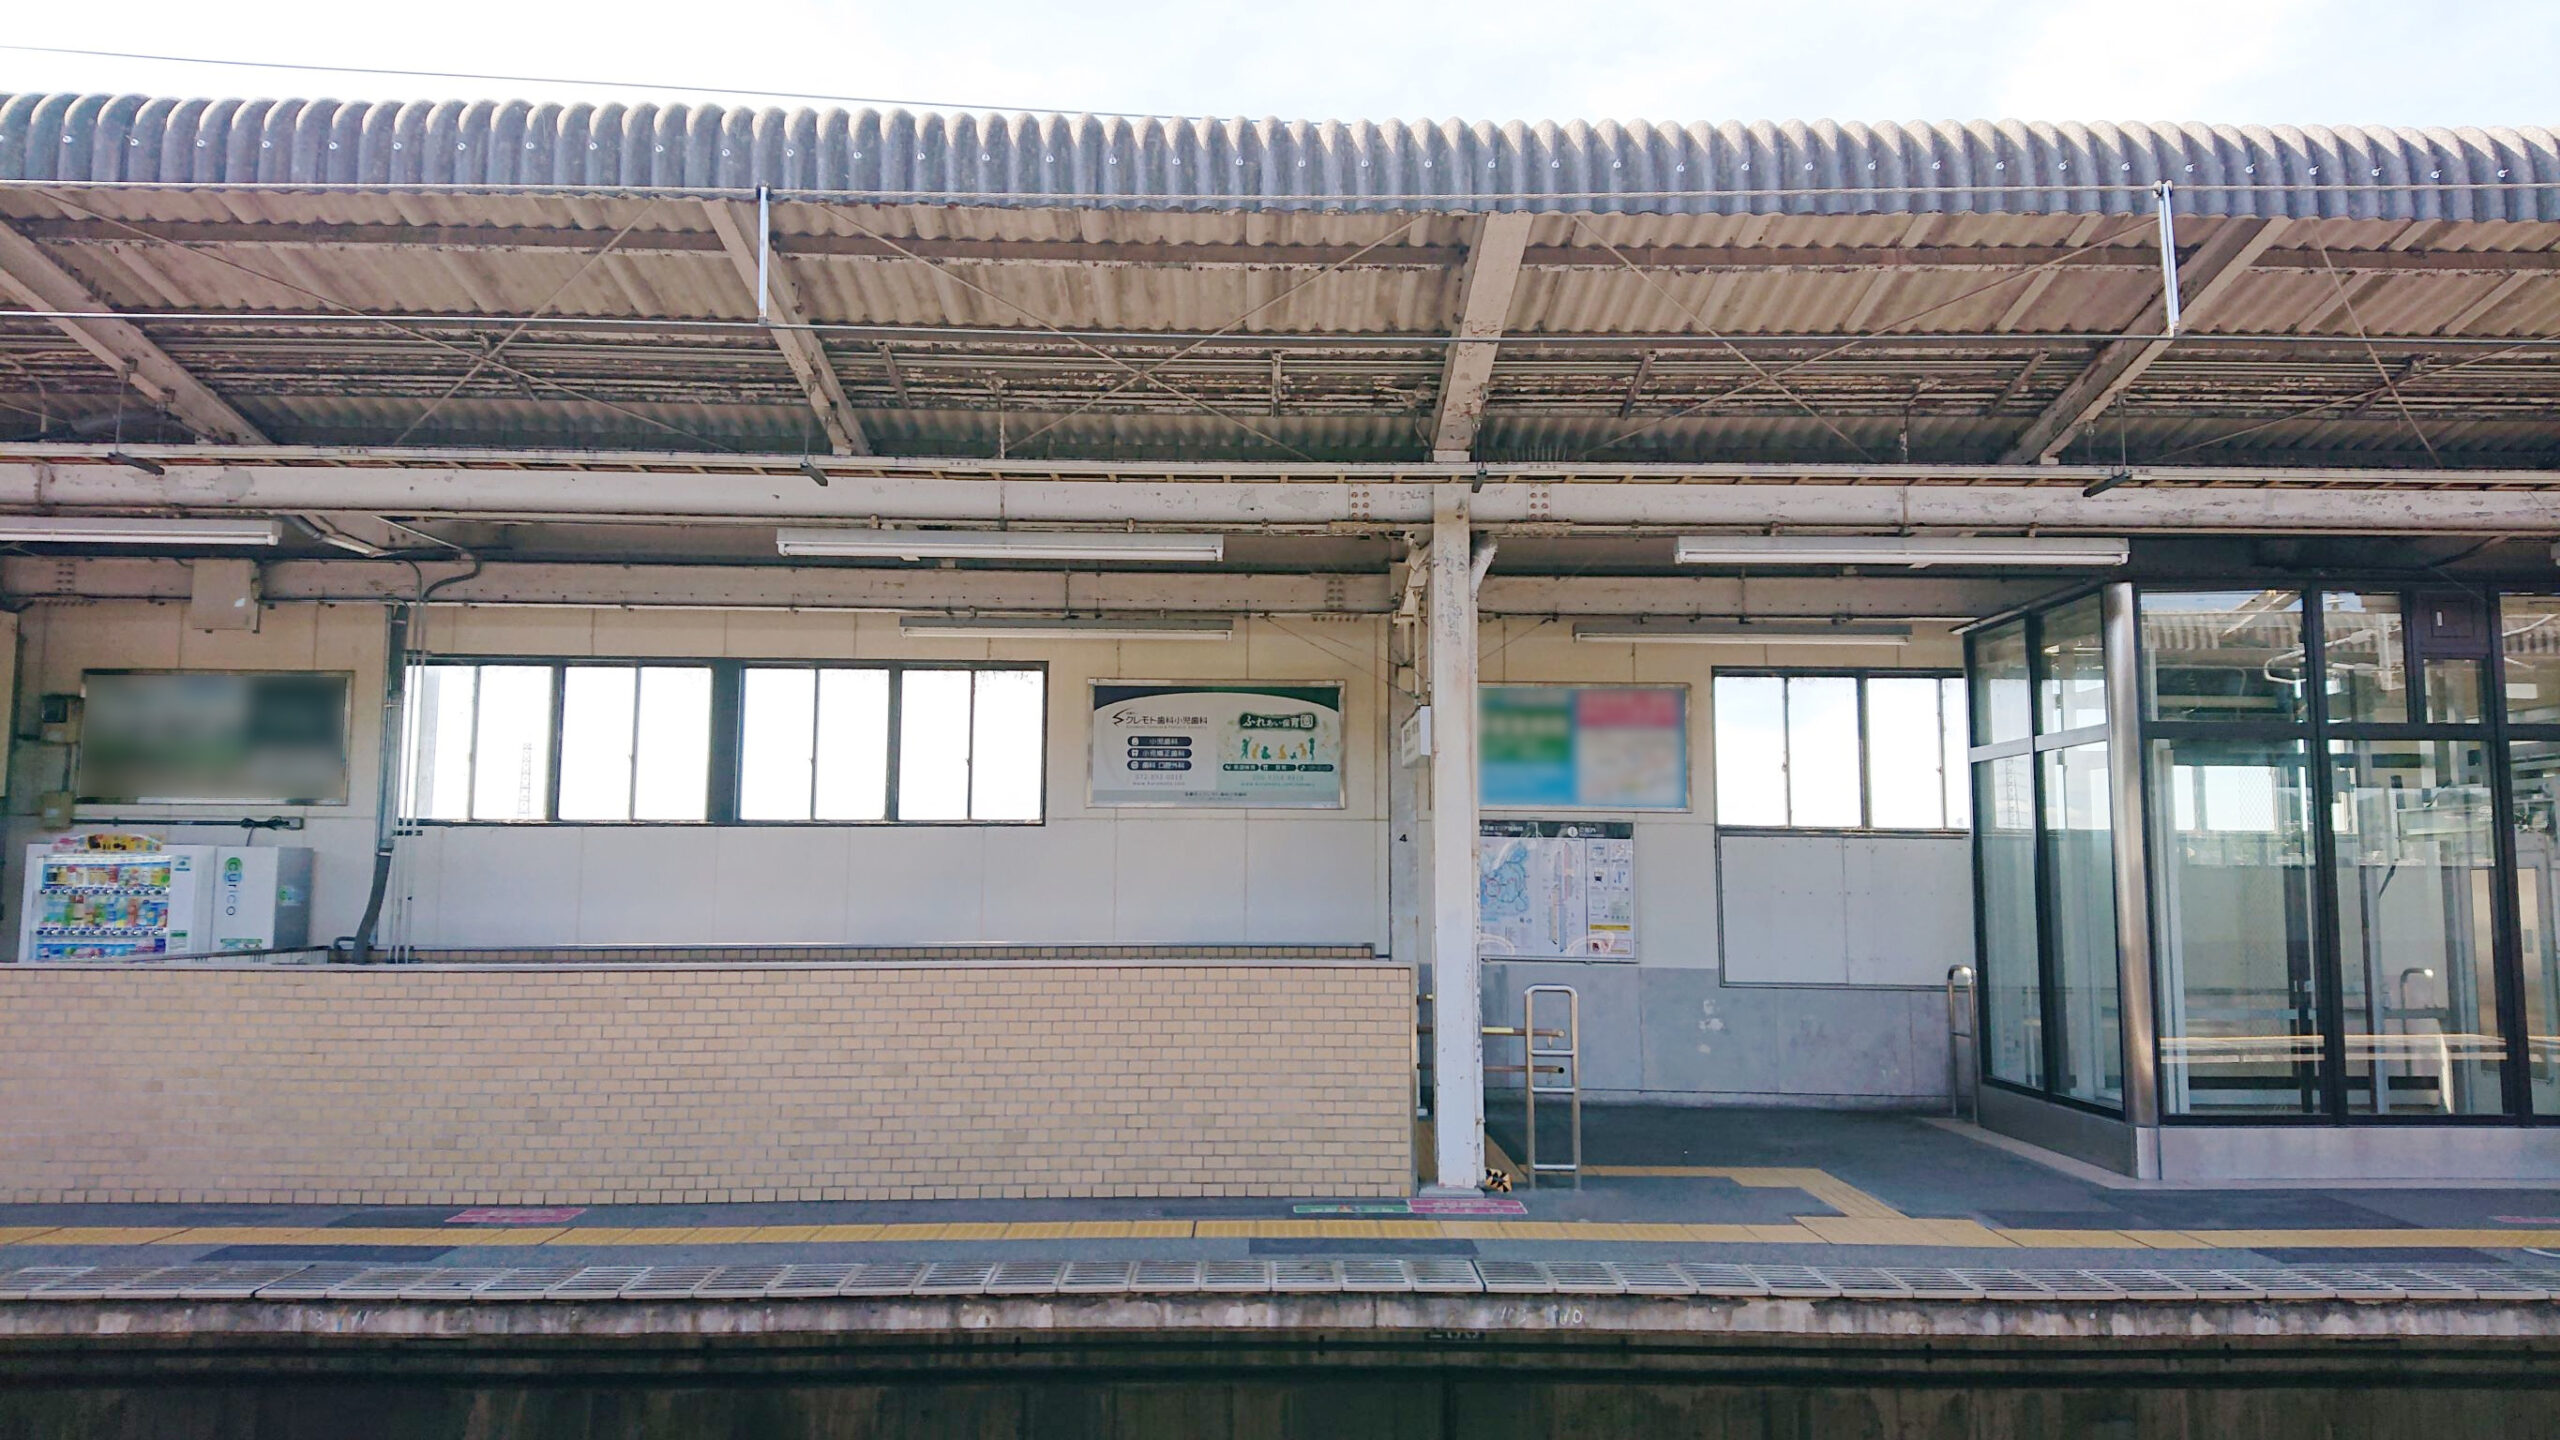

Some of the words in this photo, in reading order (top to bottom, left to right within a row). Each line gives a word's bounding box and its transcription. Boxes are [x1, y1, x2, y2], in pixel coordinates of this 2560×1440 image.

[1125, 715, 1208, 725] クレモト歯科小児歯科
[1242, 714, 1313, 728] ふれあい保育園
